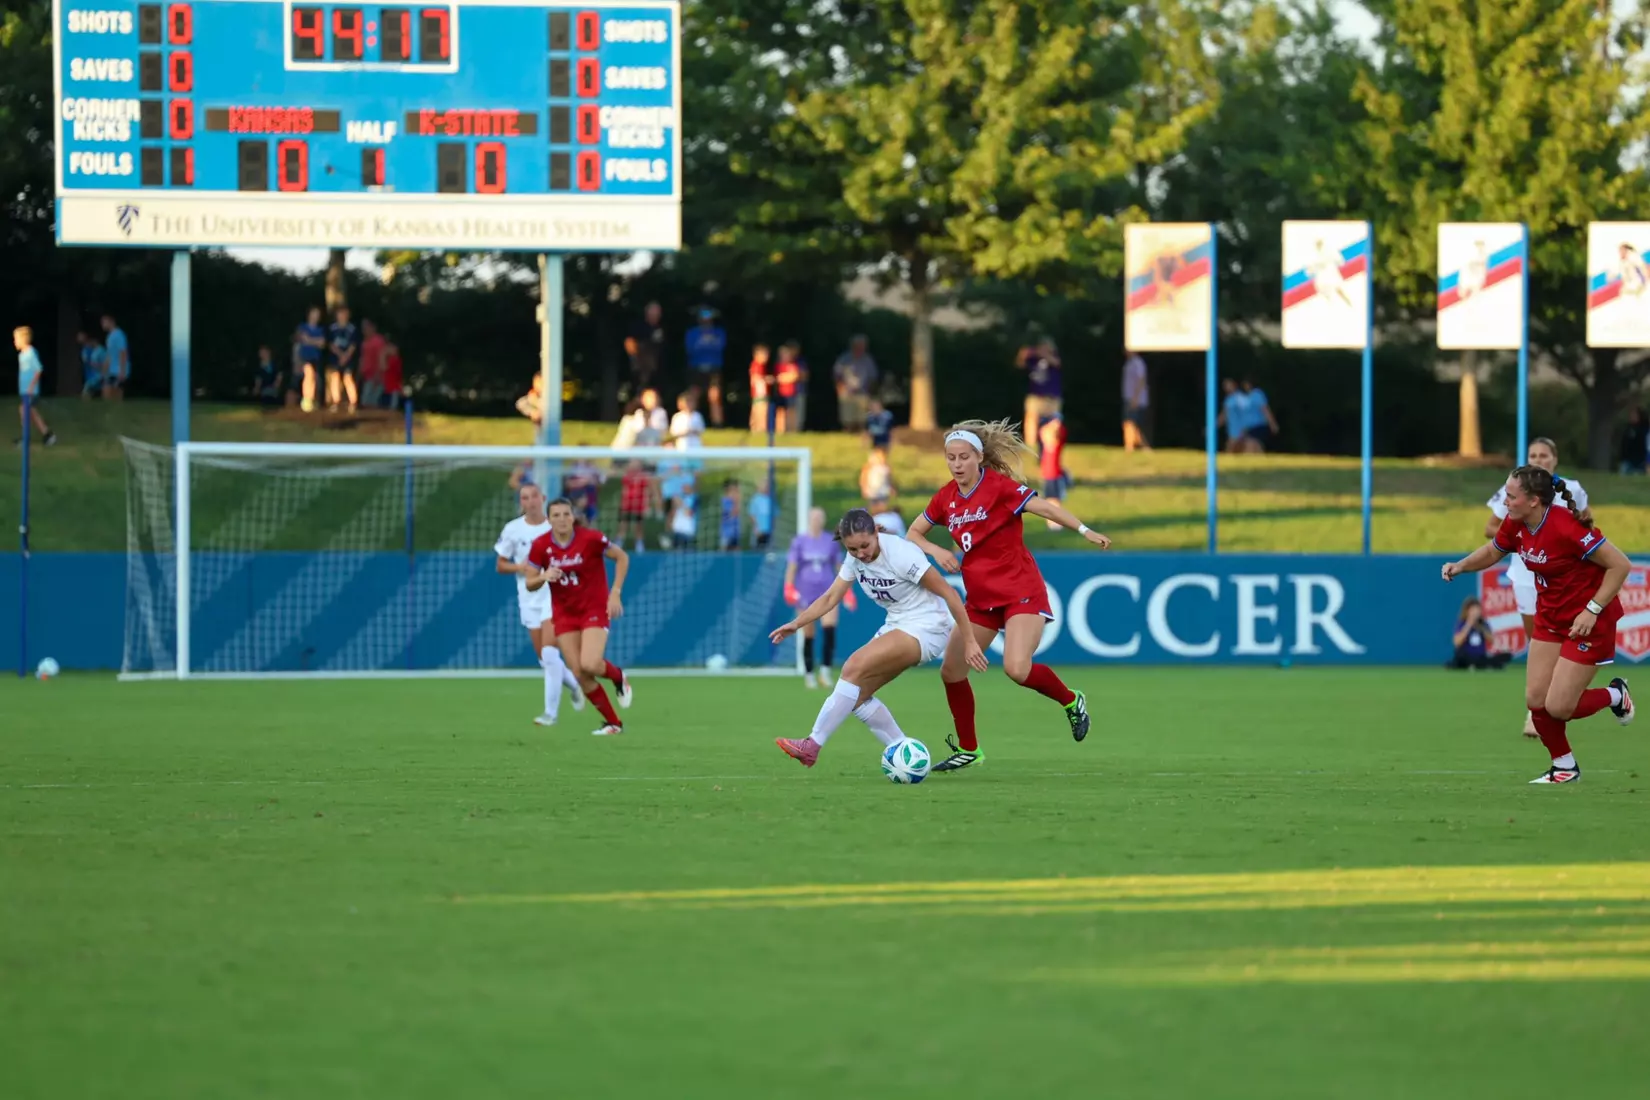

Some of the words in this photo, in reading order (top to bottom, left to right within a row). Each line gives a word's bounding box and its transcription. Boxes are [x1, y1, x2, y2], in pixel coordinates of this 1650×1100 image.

[67, 10, 133, 34] SHOTS
[168, 3, 193, 44] 0
[293, 9, 449, 58] 44:17
[576, 11, 600, 51] 0
[70, 58, 133, 81] SAVES
[168, 51, 193, 92] 0
[576, 58, 600, 98] 0
[62, 98, 141, 121] CORNER
[169, 98, 193, 140] 0
[228, 106, 314, 134] KANSAS
[419, 109, 520, 136] K-STATE
[576, 103, 600, 144] 0
[73, 119, 131, 141] KICKS
[346, 120, 397, 143] HALF
[69, 152, 133, 176] FOULS
[277, 139, 308, 192] 0
[475, 142, 506, 193] 0
[576, 150, 600, 191] 0
[148, 214, 193, 234] THE
[373, 215, 457, 237] KANSAS
[948, 506, 987, 532] Jayhawks
[961, 532, 972, 552] 8
